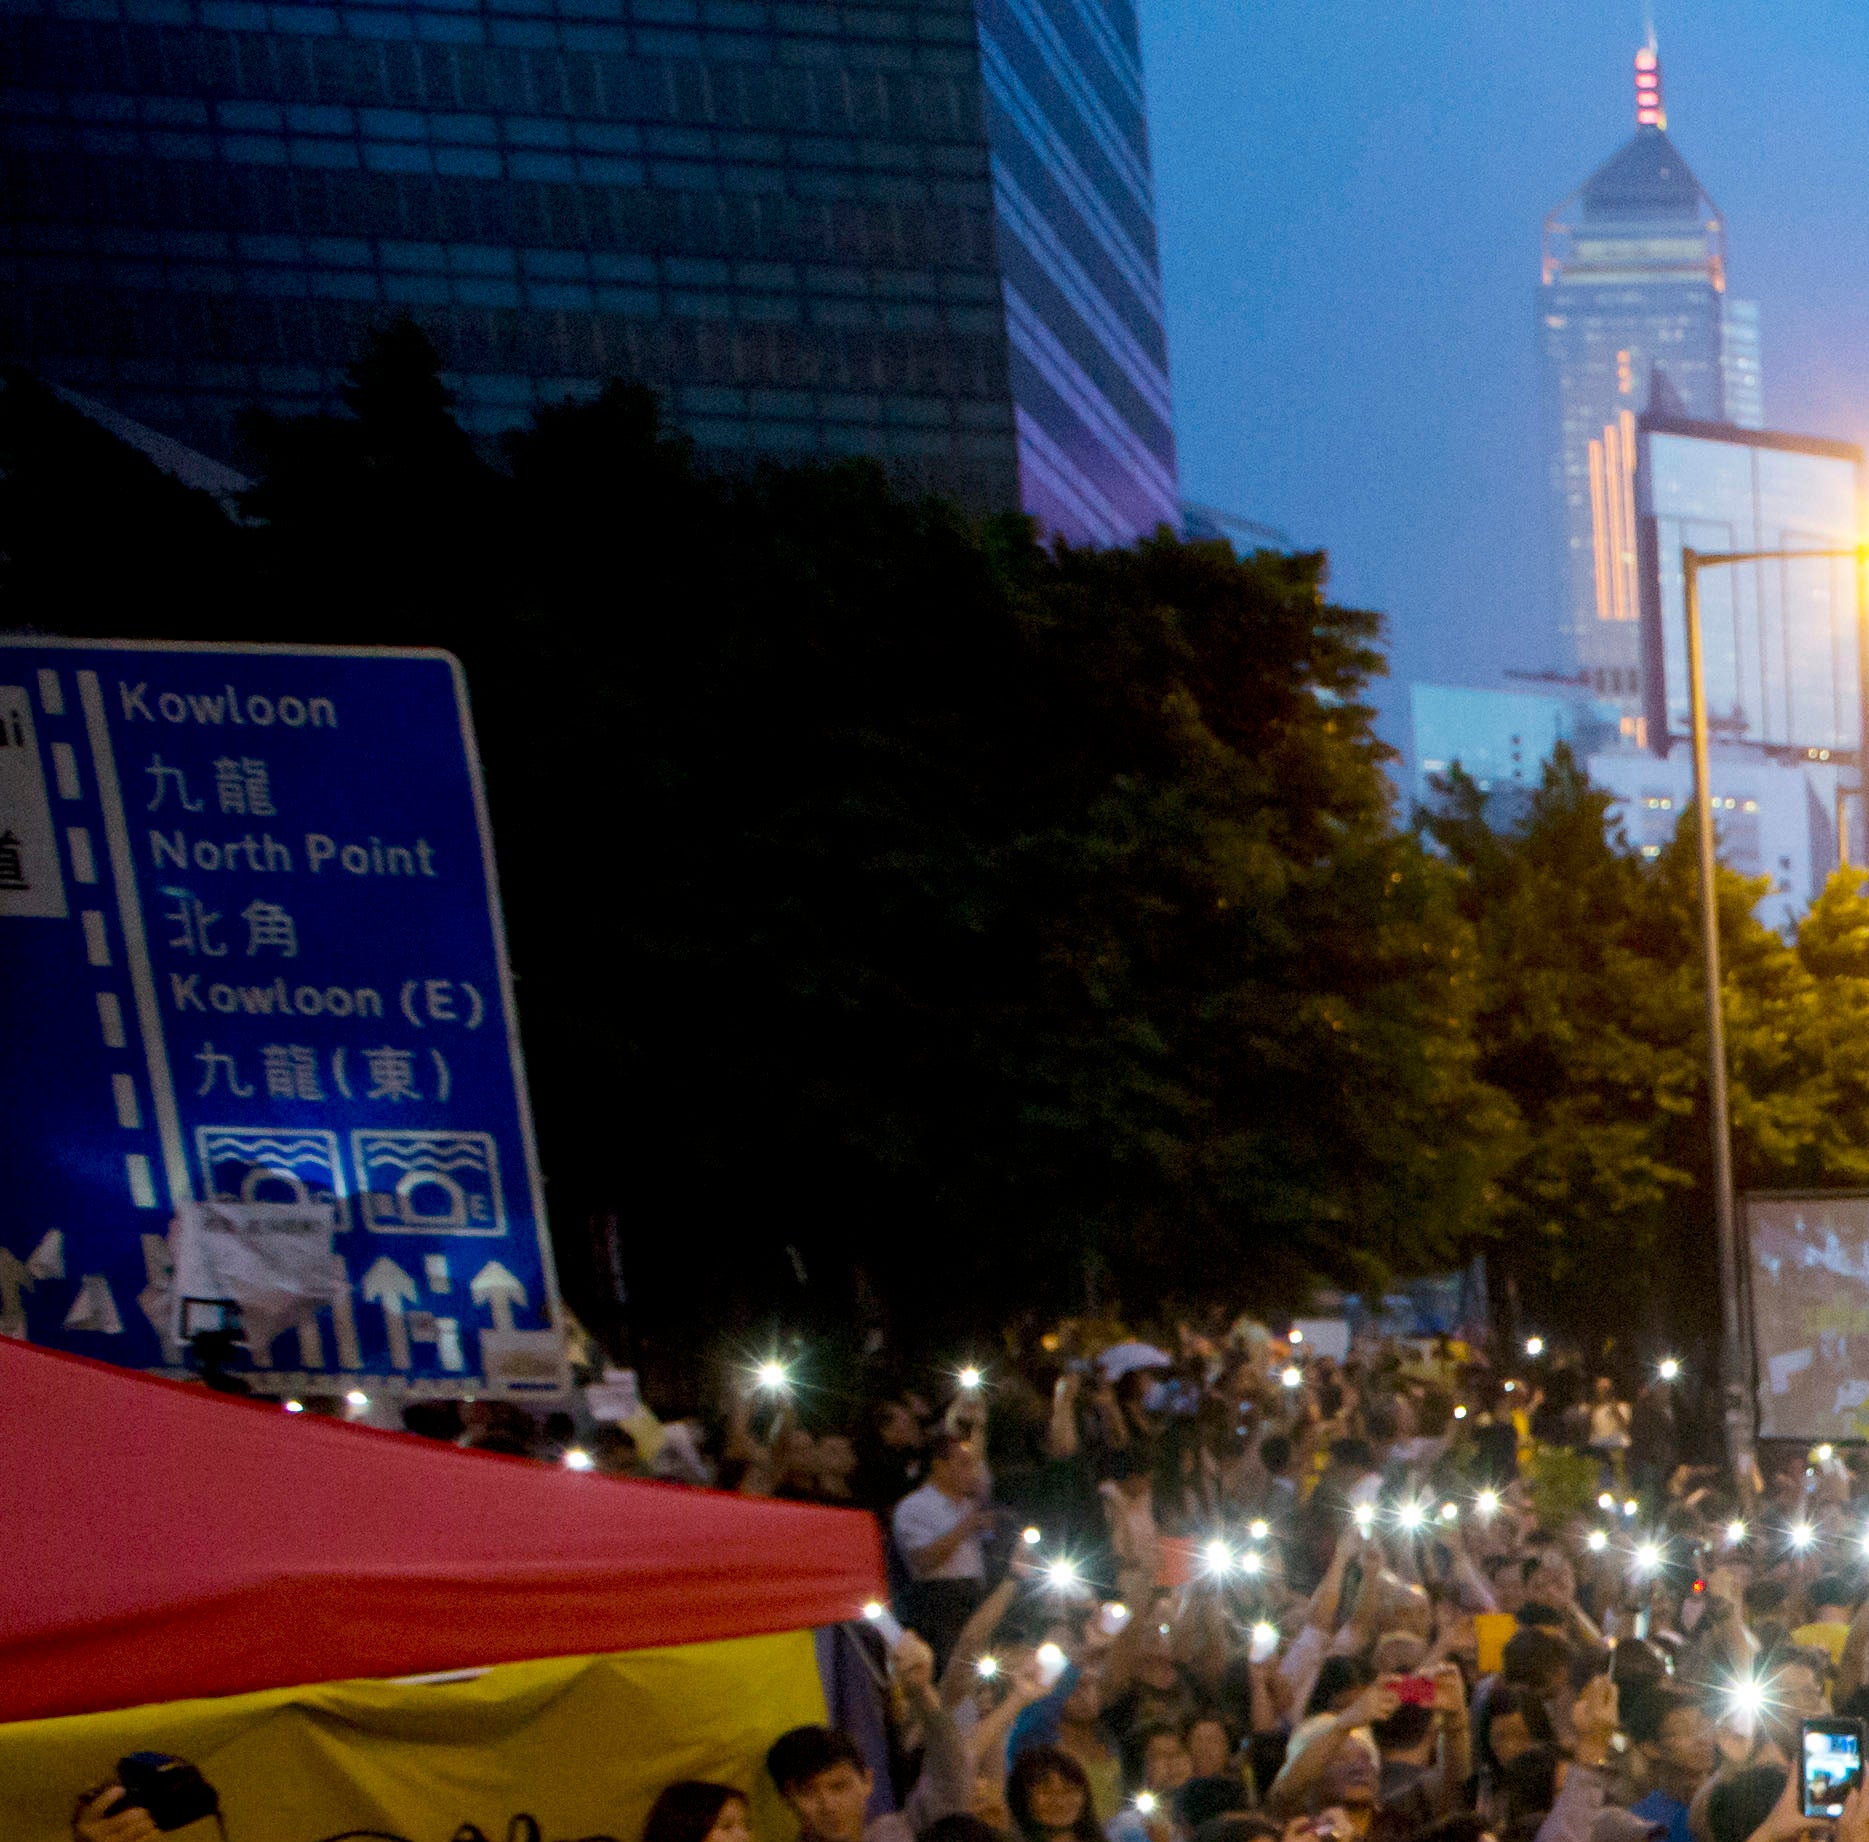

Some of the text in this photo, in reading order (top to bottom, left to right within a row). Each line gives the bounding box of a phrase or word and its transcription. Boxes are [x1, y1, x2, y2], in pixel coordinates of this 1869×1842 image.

[118, 680, 338, 728] Kowloon
[145, 754, 277, 816] 九龍
[149, 829, 437, 878] North Point
[164, 893, 299, 959] 北角
[169, 972, 485, 1029] Kowloon (E)
[194, 1043, 452, 1103] 九龍(東)
